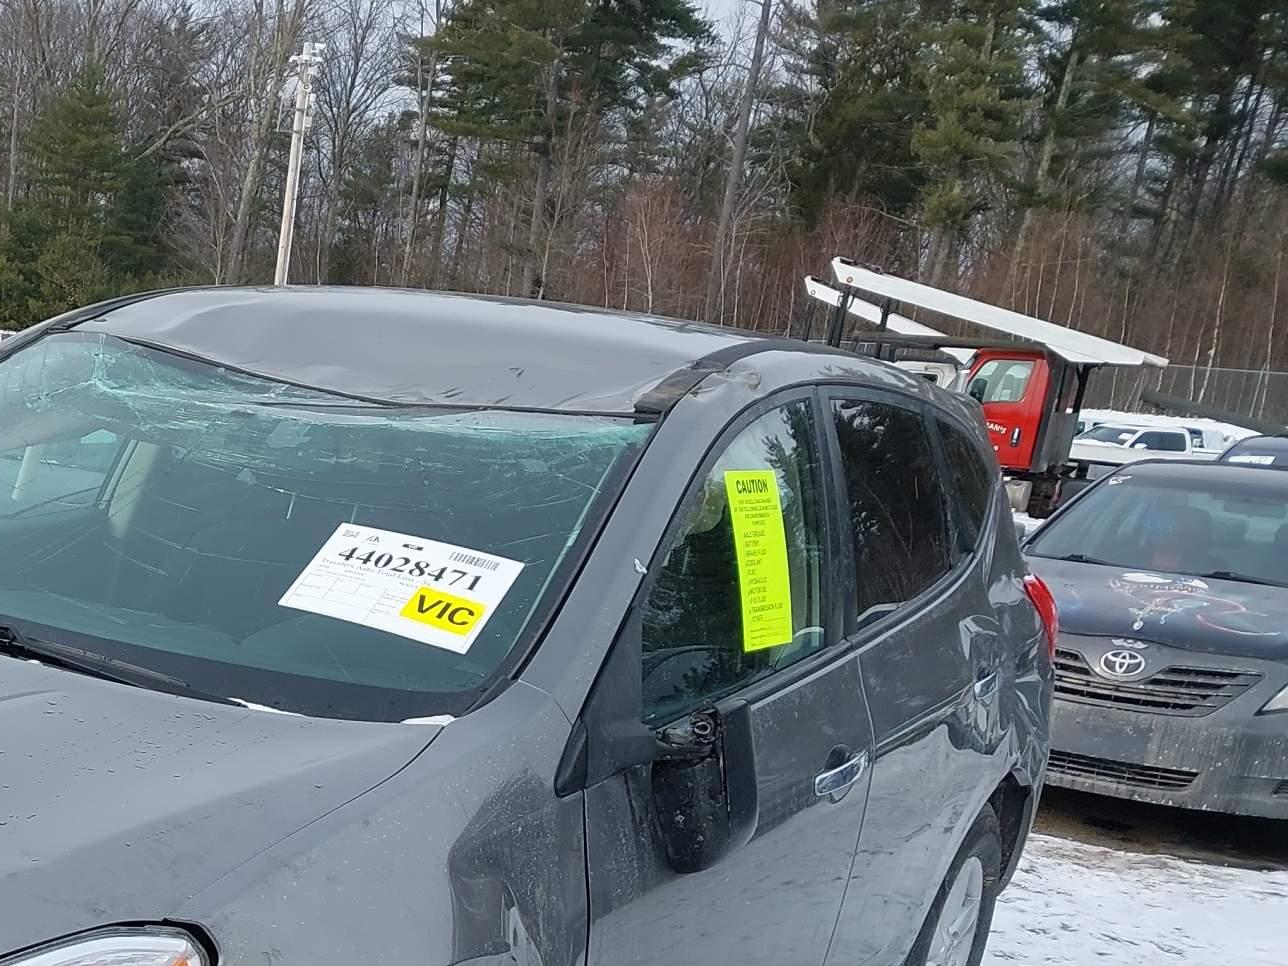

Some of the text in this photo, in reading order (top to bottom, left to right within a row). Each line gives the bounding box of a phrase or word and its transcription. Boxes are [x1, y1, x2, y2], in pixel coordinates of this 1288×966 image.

[735, 478, 769, 494] CAUTION
[338, 546, 483, 592] 44028471
[417, 594, 475, 626] VIC
